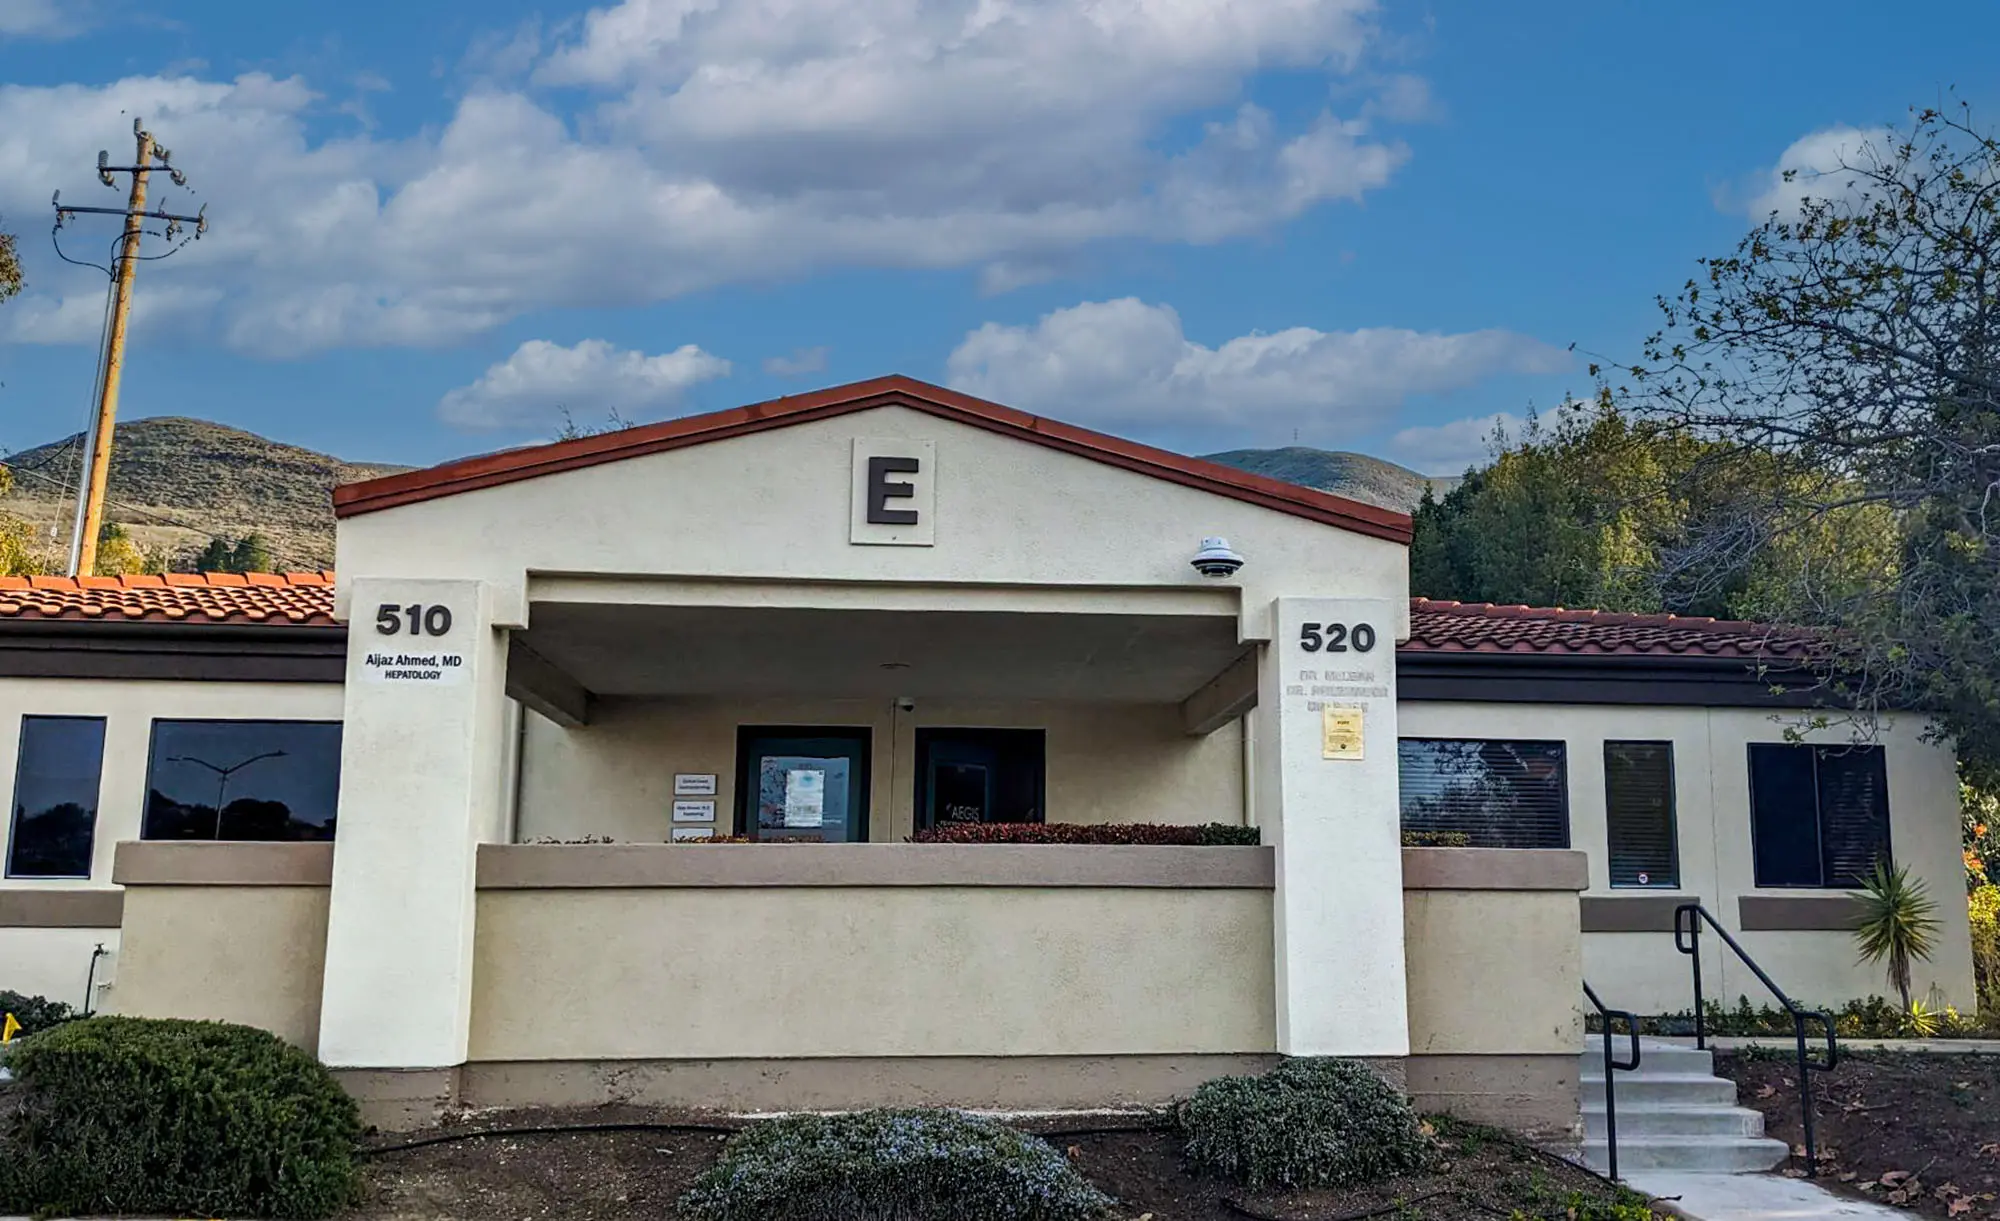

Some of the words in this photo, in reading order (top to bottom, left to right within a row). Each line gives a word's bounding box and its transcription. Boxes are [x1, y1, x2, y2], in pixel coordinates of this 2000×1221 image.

[866, 456, 920, 526] E
[375, 603, 453, 637] 510
[1300, 622, 1376, 653] 520
[365, 654, 393, 668] Aijaz
[395, 654, 439, 668] Ahmed,
[442, 655, 462, 667] MD
[384, 670, 442, 680] HEPATOLOGY
[951, 804, 980, 821] AEGIS
